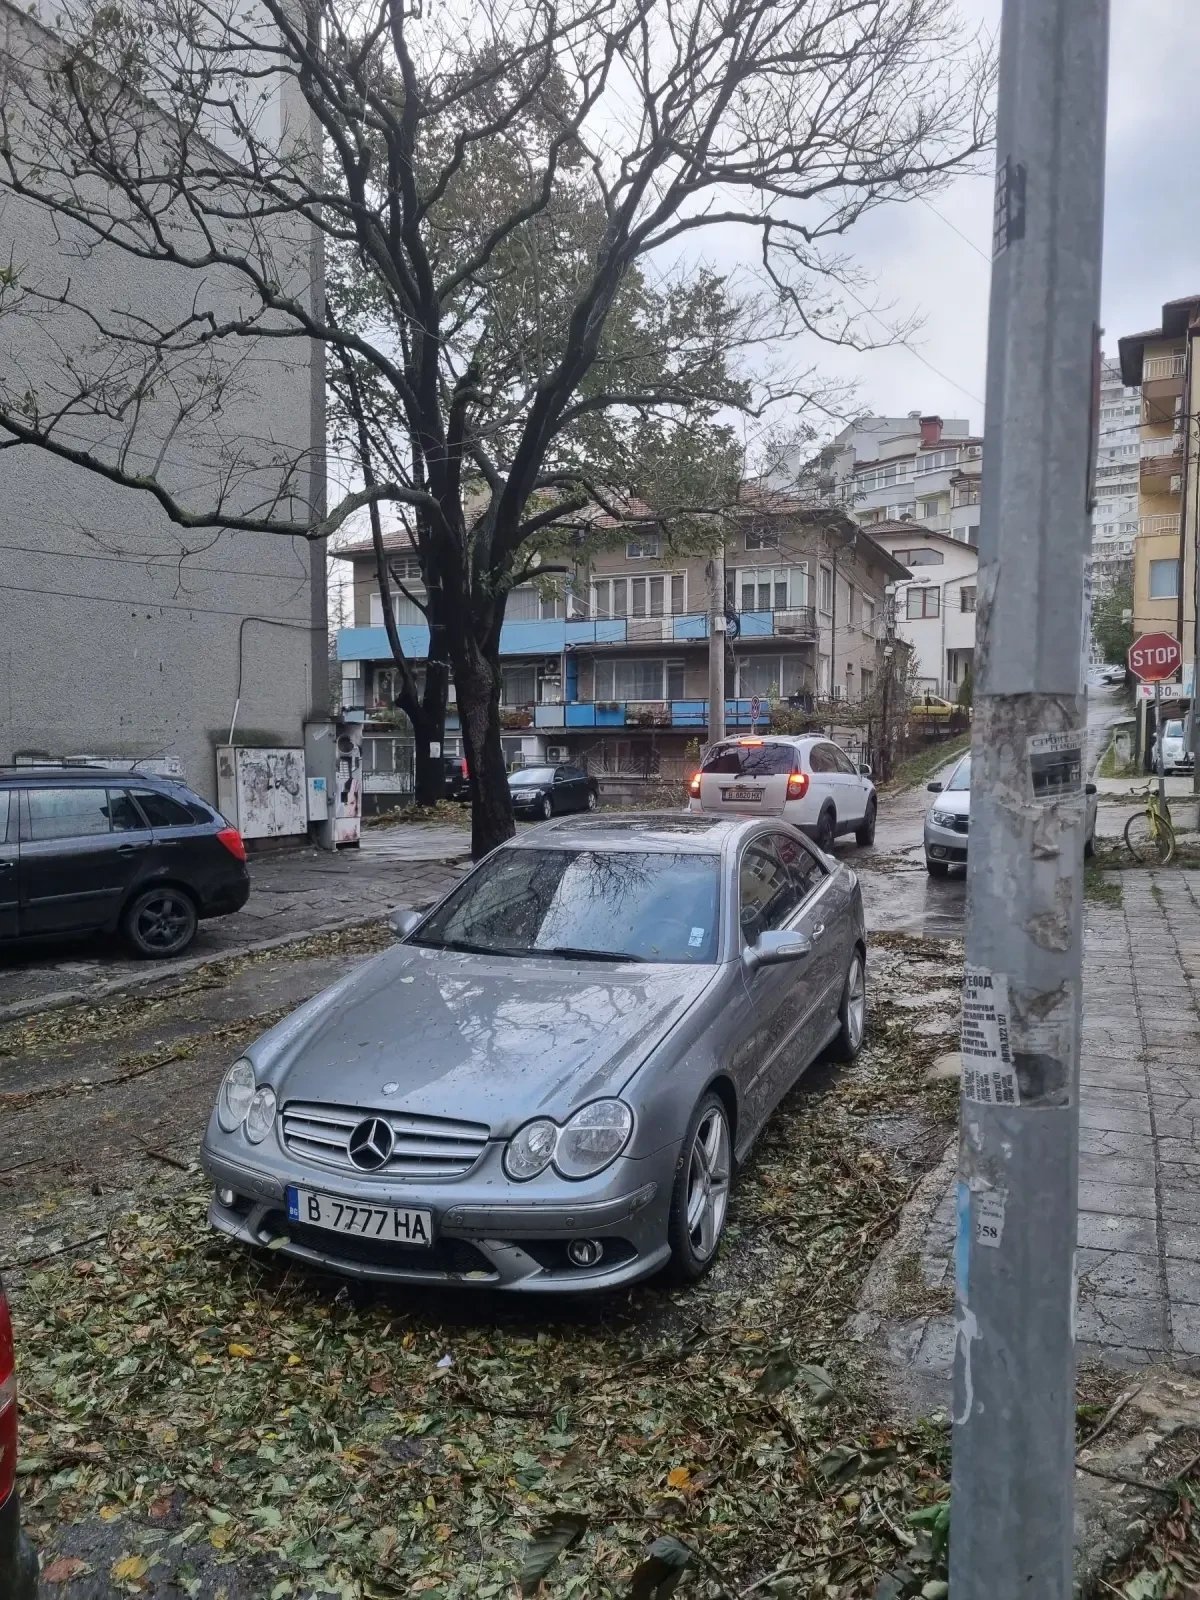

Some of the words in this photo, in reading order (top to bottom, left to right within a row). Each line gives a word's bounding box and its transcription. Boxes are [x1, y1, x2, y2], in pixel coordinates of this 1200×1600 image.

[1133, 646, 1177, 667] STOP
[289, 1207, 298, 1216] BG
[308, 1196, 321, 1221] B
[332, 1203, 388, 1235] 7777
[394, 1211, 428, 1240] HA
